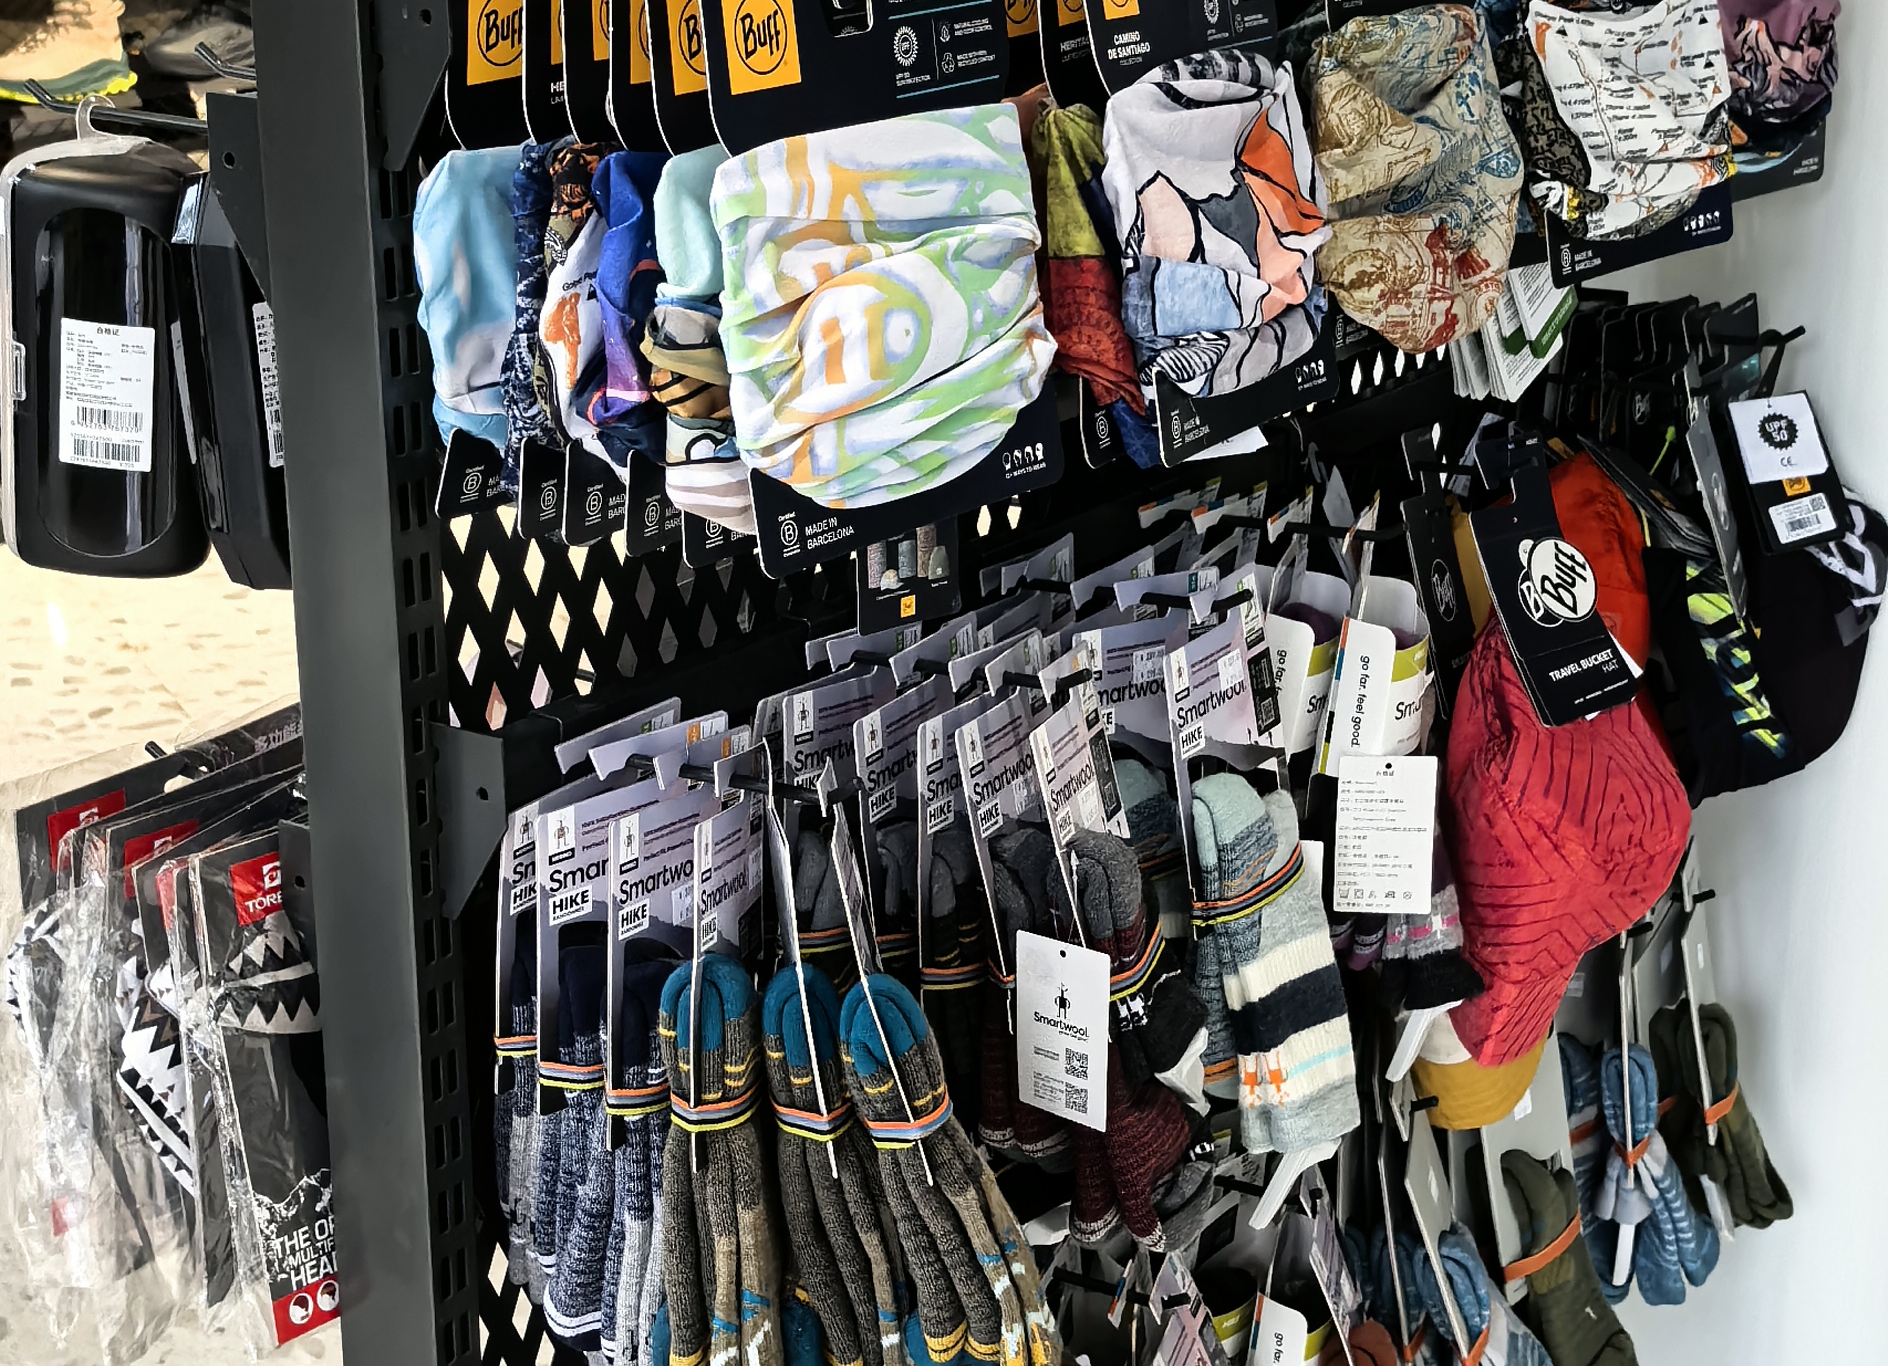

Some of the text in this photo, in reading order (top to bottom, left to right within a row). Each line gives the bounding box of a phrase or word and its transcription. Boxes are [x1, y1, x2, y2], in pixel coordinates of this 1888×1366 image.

[741, 9, 781, 61] Buff
[1765, 419, 1788, 433] UPF
[1771, 430, 1788, 442] 50
[805, 516, 838, 537] MADE IN
[807, 525, 855, 550] BARCELONA
[1540, 542, 1587, 616] Buff
[1277, 649, 1287, 665] go
[1549, 648, 1614, 682] TRAVEL BUCKET
[1601, 658, 1620, 673] HAT
[1275, 666, 1287, 684] far.
[1098, 678, 1166, 707] martwo
[1177, 680, 1247, 729] Smartwool
[1350, 655, 1370, 748] go far. feel good.
[1181, 726, 1204, 748] HIKE
[974, 753, 1032, 806] Smartwoo
[871, 786, 895, 813] HIKE
[929, 800, 953, 824] HIKE
[980, 802, 1000, 827] HIKE
[552, 889, 590, 916] HIKE
[621, 903, 648, 929] HIKE
[1033, 1011, 1090, 1040] Smartwool
[273, 1225, 312, 1259] THE
[1273, 1332, 1284, 1348] go
